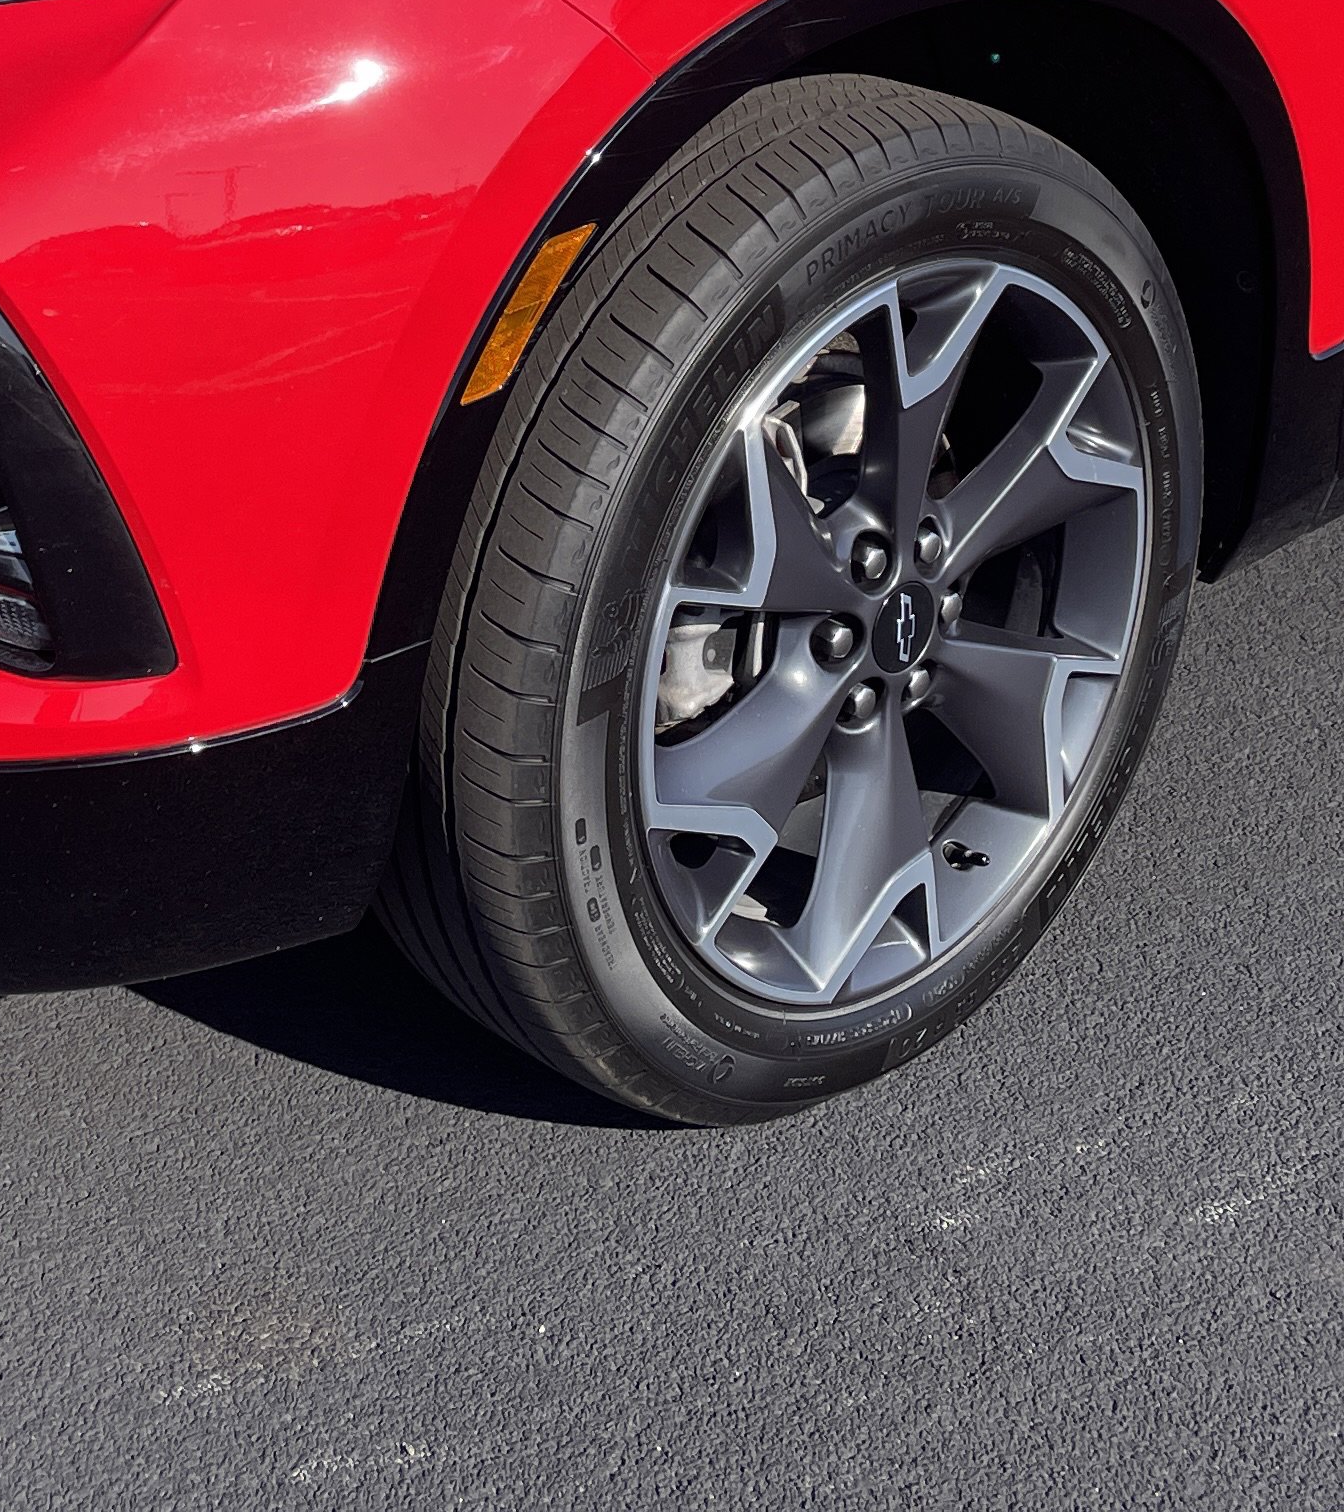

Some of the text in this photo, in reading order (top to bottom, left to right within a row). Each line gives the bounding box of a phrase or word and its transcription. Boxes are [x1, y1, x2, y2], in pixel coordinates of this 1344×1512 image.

[806, 186, 1023, 280] PRIMACY TOUR A/S
